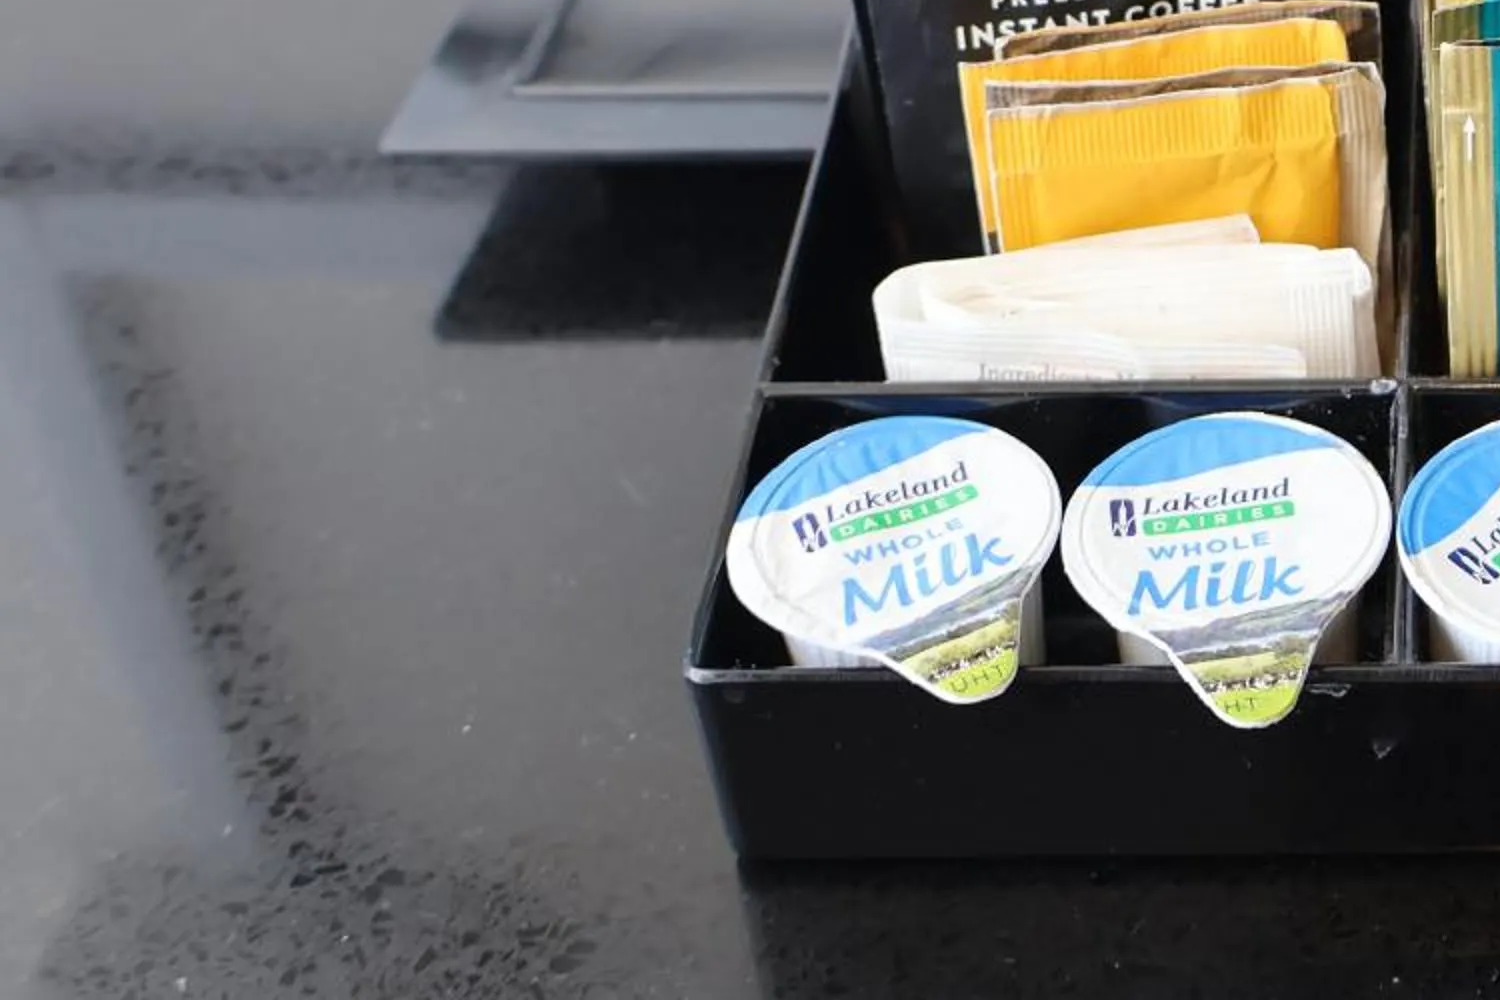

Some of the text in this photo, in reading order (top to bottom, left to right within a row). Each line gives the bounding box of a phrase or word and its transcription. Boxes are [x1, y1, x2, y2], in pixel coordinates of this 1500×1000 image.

[826, 461, 968, 523] Lakeland
[839, 490, 973, 537] DAIRIES
[1143, 477, 1289, 515] Lakeland
[844, 516, 966, 566] WHOLE
[1152, 505, 1287, 534] DAIRIES
[1146, 531, 1271, 561] WHOLE
[842, 533, 1015, 627] Milk
[1127, 556, 1305, 616] Milk
[950, 665, 1003, 693] UHT
